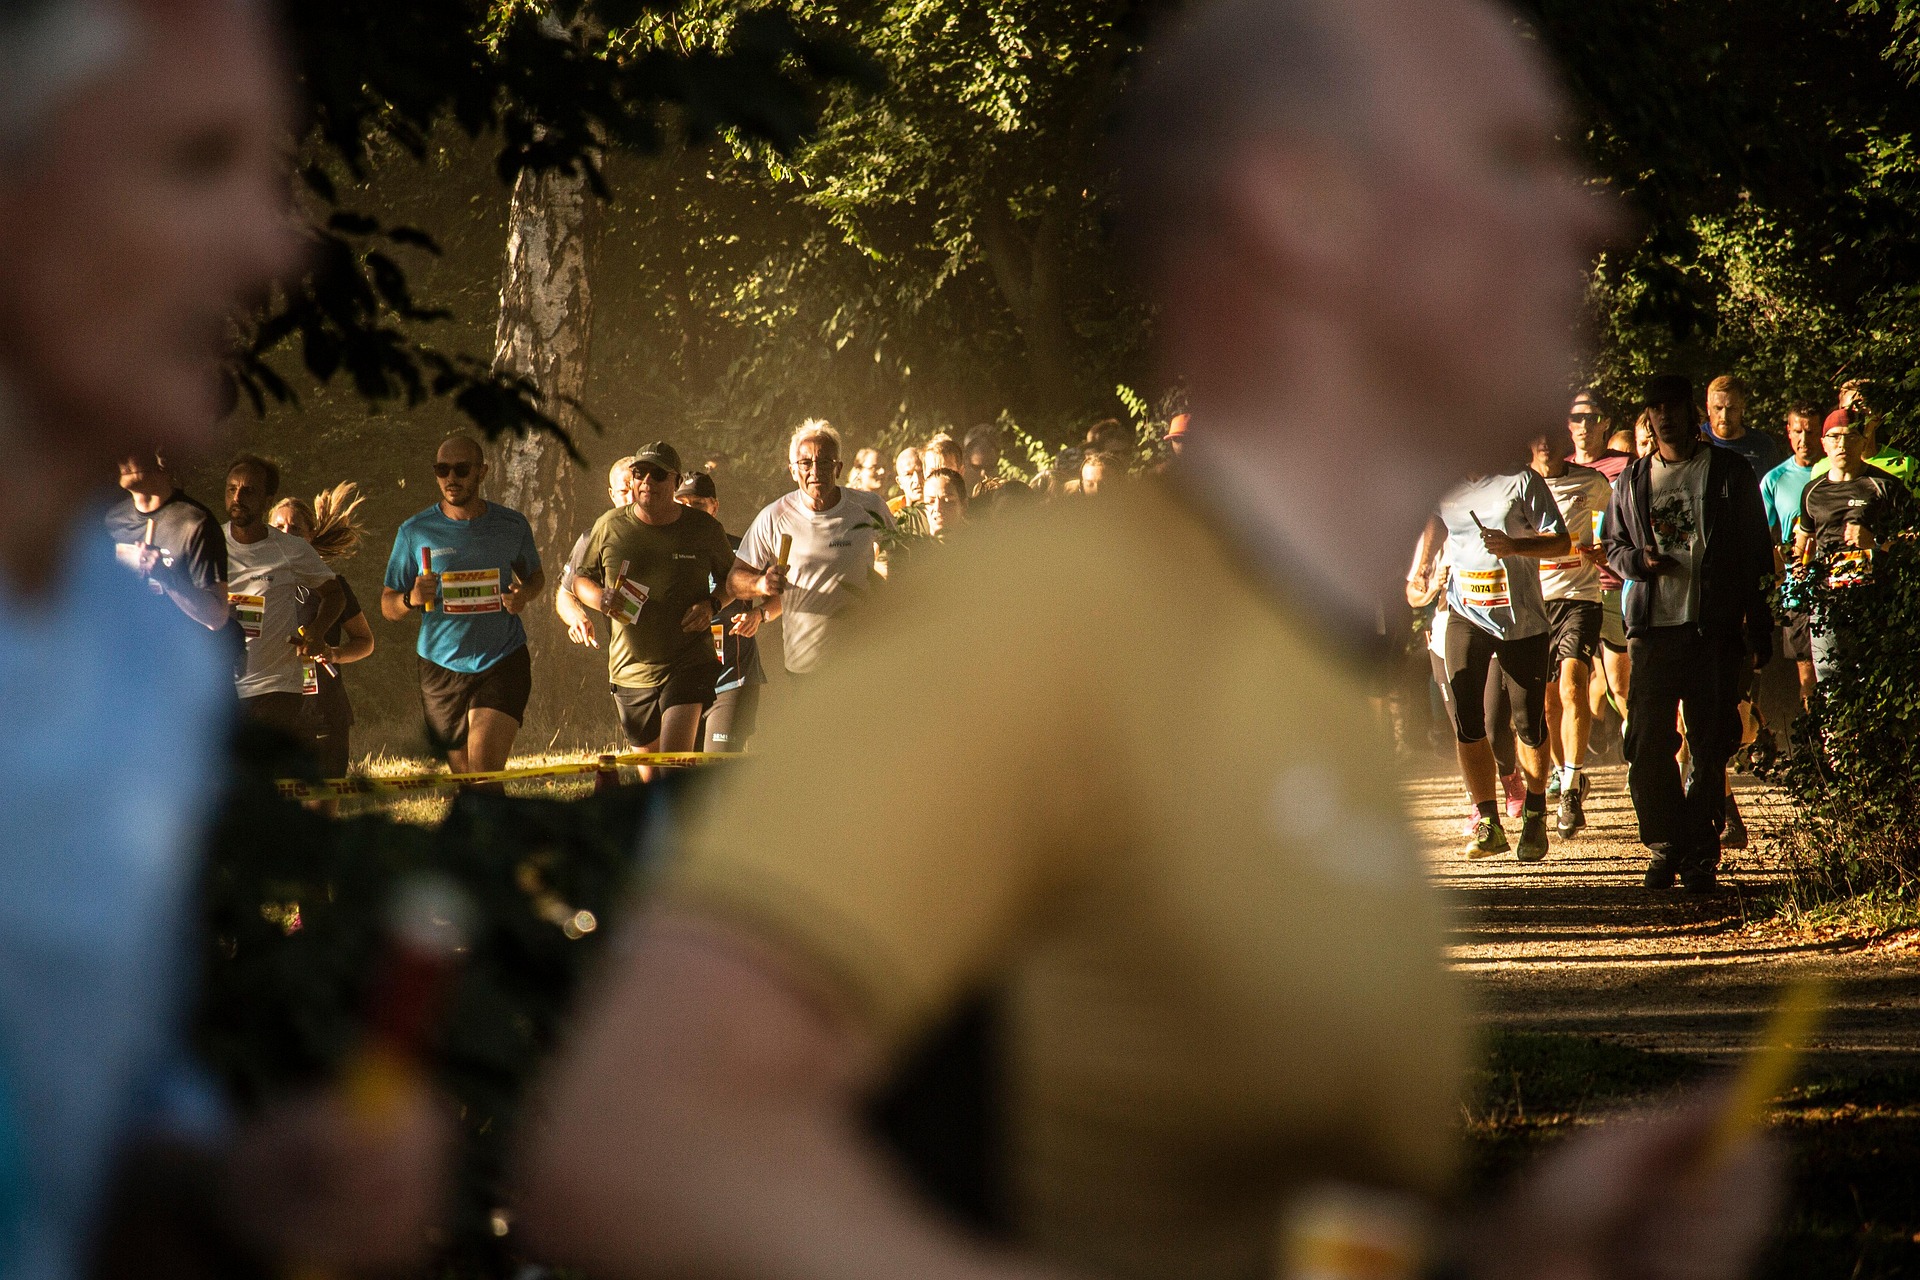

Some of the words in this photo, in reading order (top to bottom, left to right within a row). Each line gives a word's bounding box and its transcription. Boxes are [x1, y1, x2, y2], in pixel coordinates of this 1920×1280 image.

[453, 571, 486, 581] DHL
[1467, 571, 1495, 579] DHL
[458, 586, 481, 598] 1971
[1470, 584, 1491, 593] 2074
